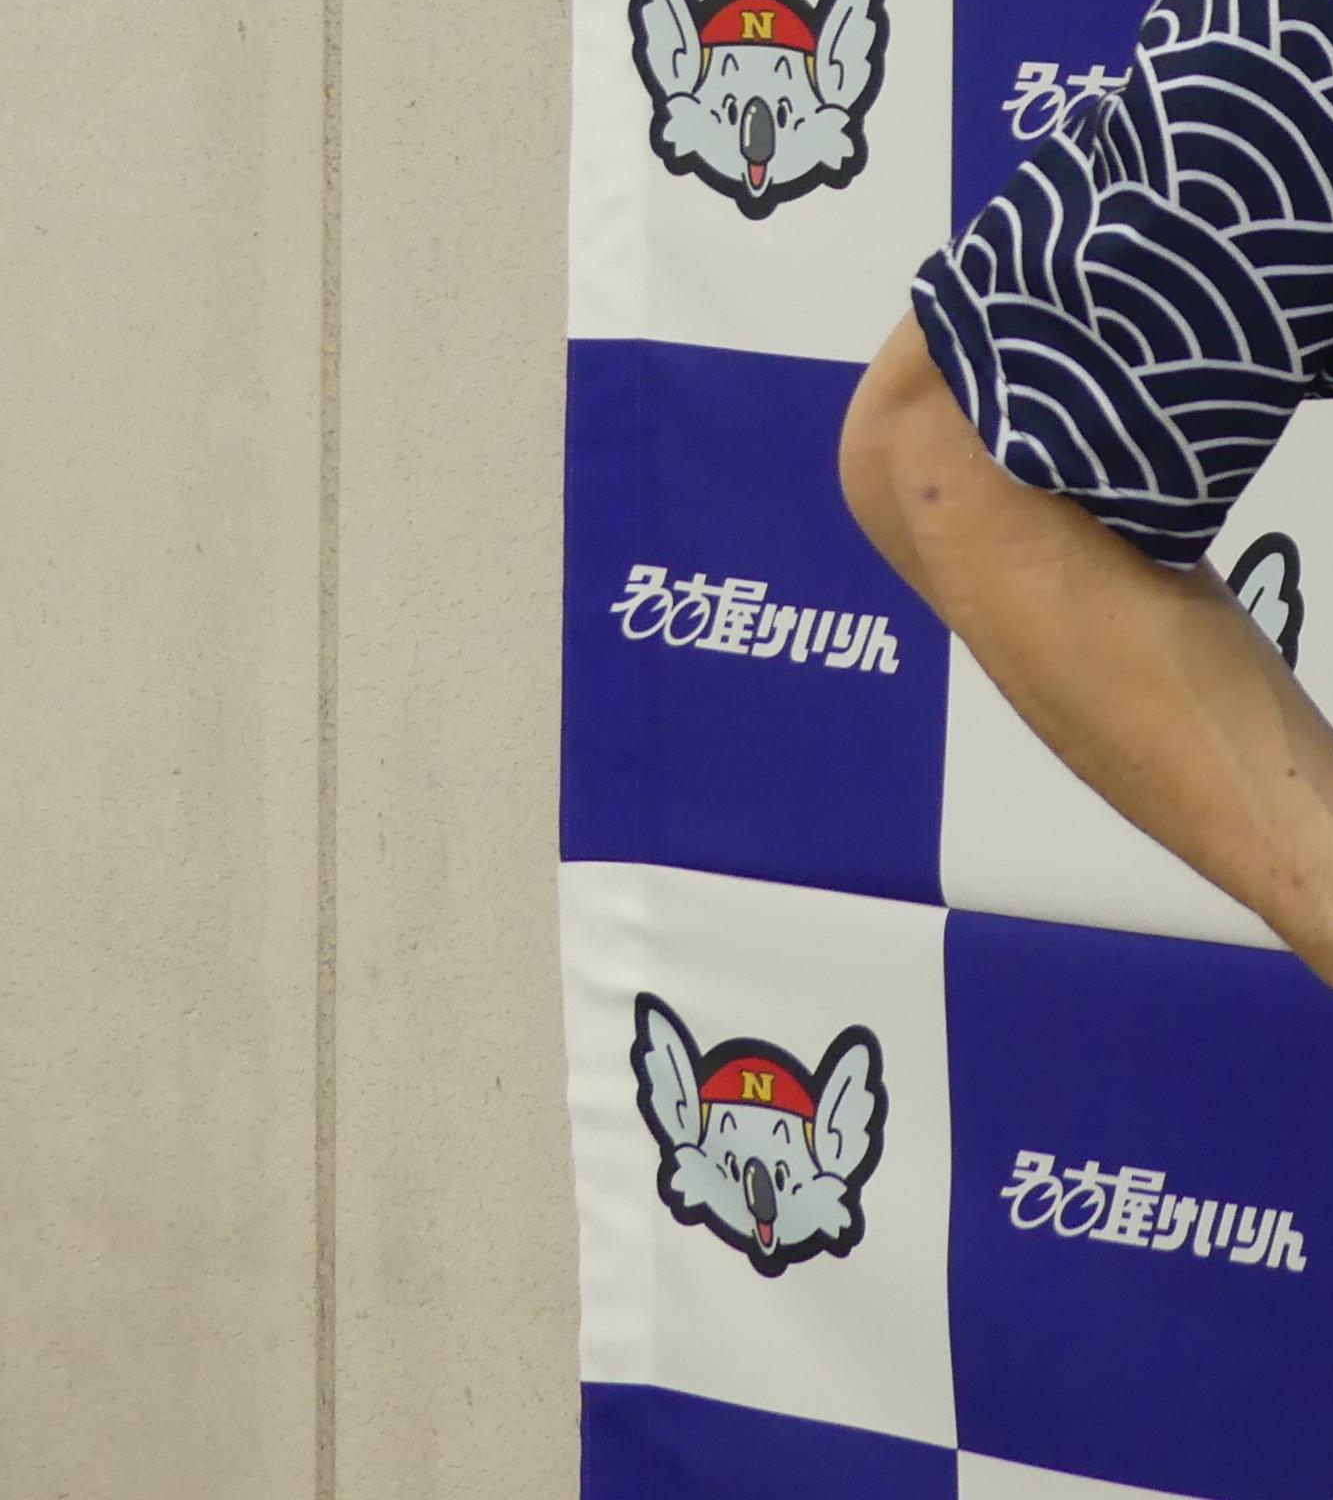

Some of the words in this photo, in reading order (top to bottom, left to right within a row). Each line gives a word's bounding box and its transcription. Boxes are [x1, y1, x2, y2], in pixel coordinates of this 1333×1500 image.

[741, 12, 775, 40] N
[611, 565, 899, 674] 名古屋けいりん
[741, 1072, 773, 1102] N
[1000, 1151, 1306, 1272] 名古屋けいりん
